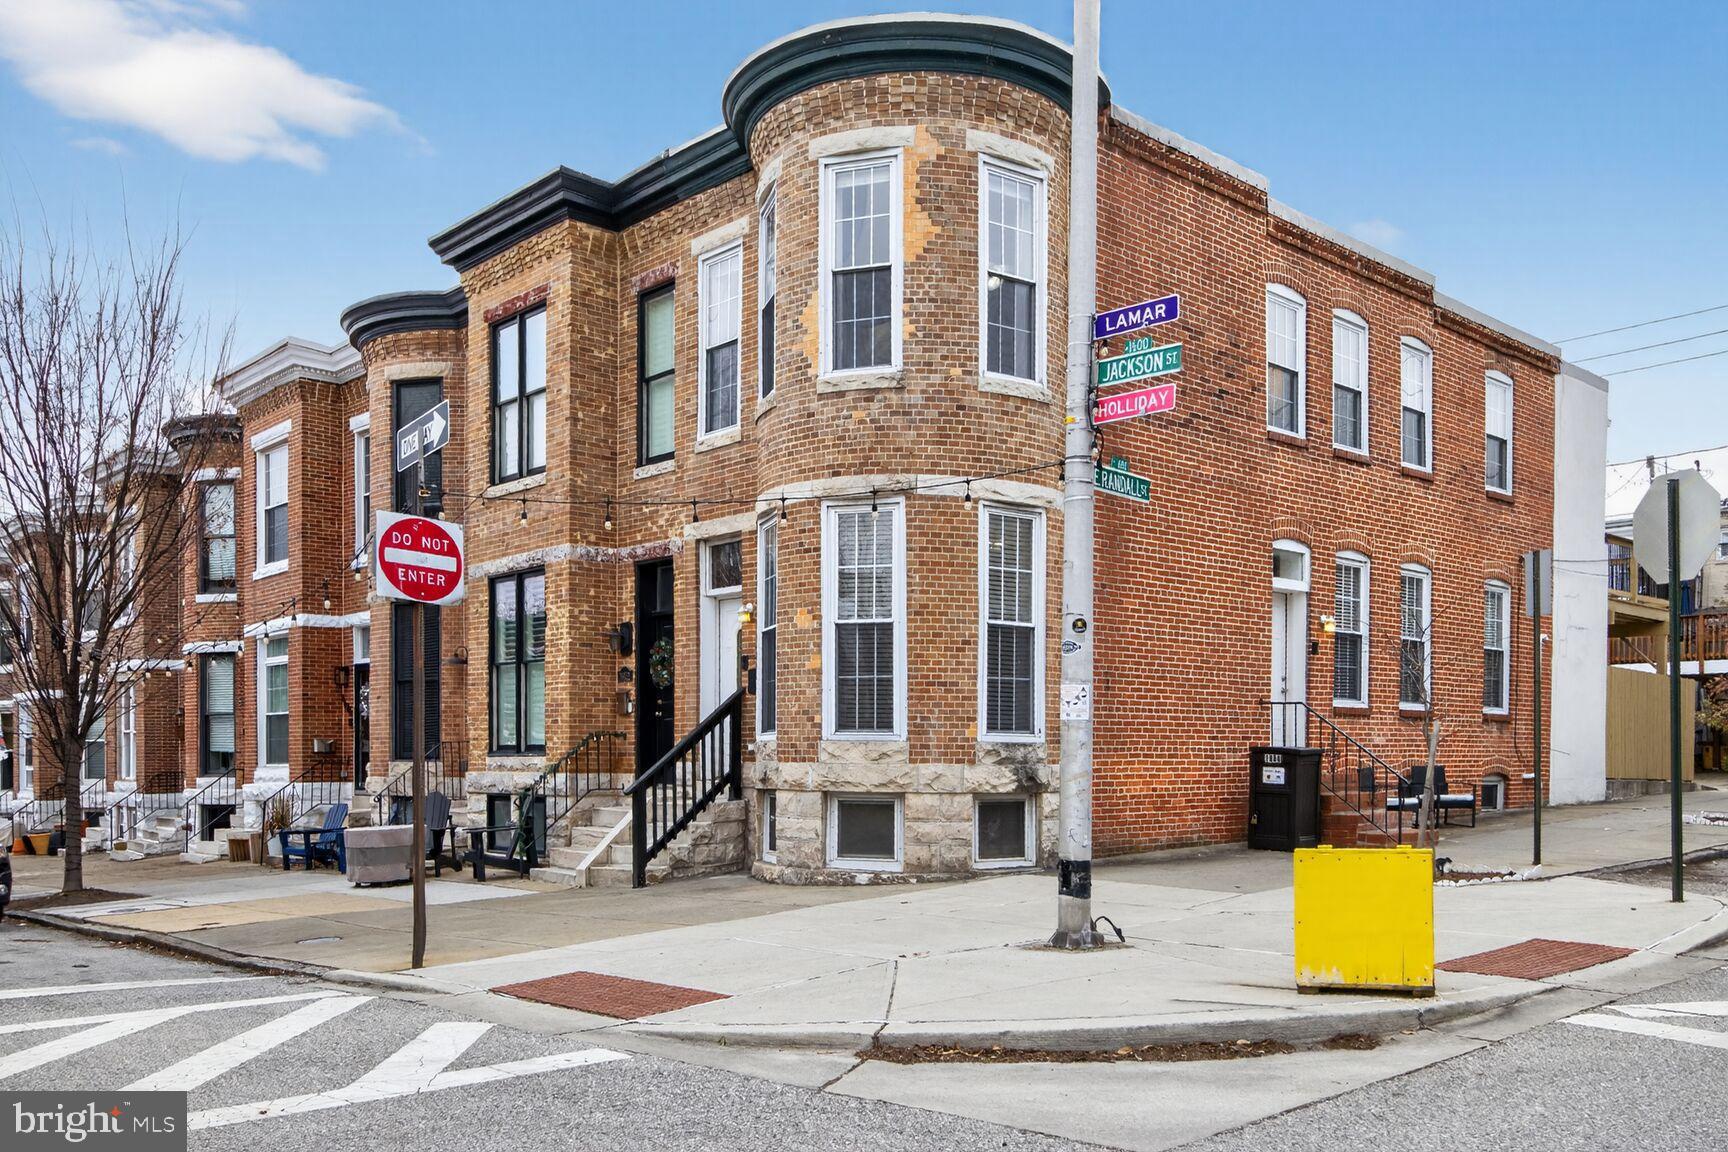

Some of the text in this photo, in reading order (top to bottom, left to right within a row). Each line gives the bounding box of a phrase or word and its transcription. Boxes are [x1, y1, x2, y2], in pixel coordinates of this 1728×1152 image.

[1105, 303, 1166, 332] LAMAR
[1102, 351, 1178, 382] JACKSON ST
[1098, 390, 1169, 418] HOLLIDAY
[402, 433, 417, 456] ONE
[1094, 468, 1101, 486] E
[1101, 470, 1141, 497] RANDALL
[392, 531, 450, 552] DO NOT
[398, 567, 446, 587] ENTER
